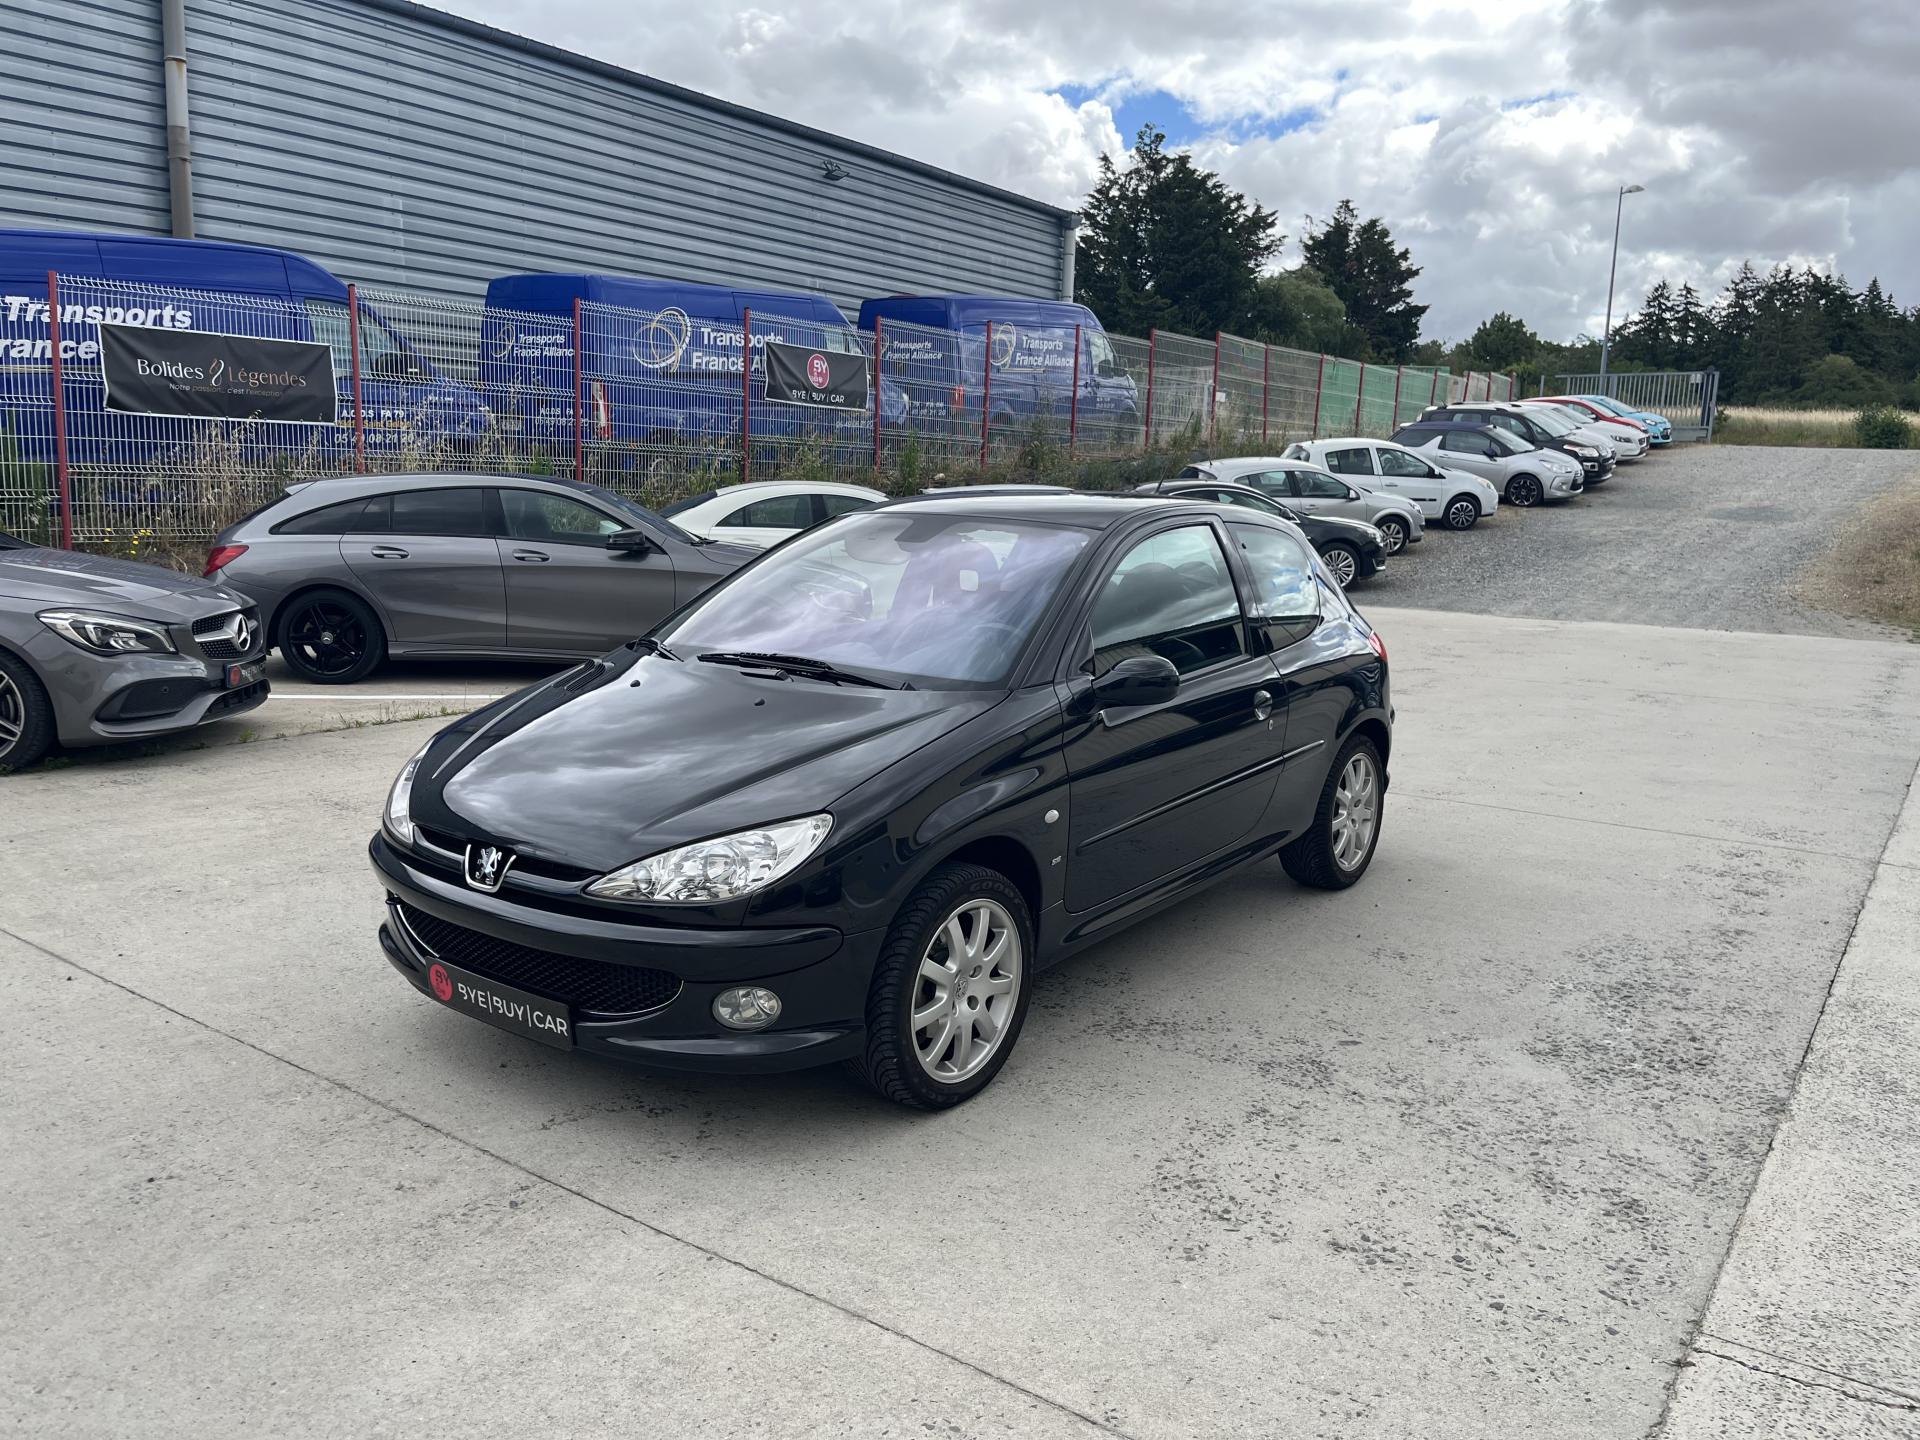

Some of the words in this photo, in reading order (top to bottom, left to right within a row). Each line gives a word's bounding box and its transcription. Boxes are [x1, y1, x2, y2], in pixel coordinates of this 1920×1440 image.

[5, 296, 192, 328] Transports
[519, 333, 565, 345] Transports
[894, 340, 932, 350] Transports
[1023, 335, 1063, 352] Transports
[0, 338, 99, 359] rance
[513, 346, 541, 357] France
[543, 346, 576, 357] Allianc
[886, 351, 911, 360] France
[912, 351, 943, 360] Alliance
[692, 352, 745, 371] France
[1016, 352, 1043, 366] France
[1045, 354, 1075, 367] Alliance
[137, 358, 205, 380] Bolides
[228, 366, 307, 388] Légendes
[169, 383, 191, 391] Notre
[227, 387, 245, 395] c'est
[792, 390, 806, 400] BYE
[812, 392, 826, 402] BUY
[830, 394, 845, 404] CAR
